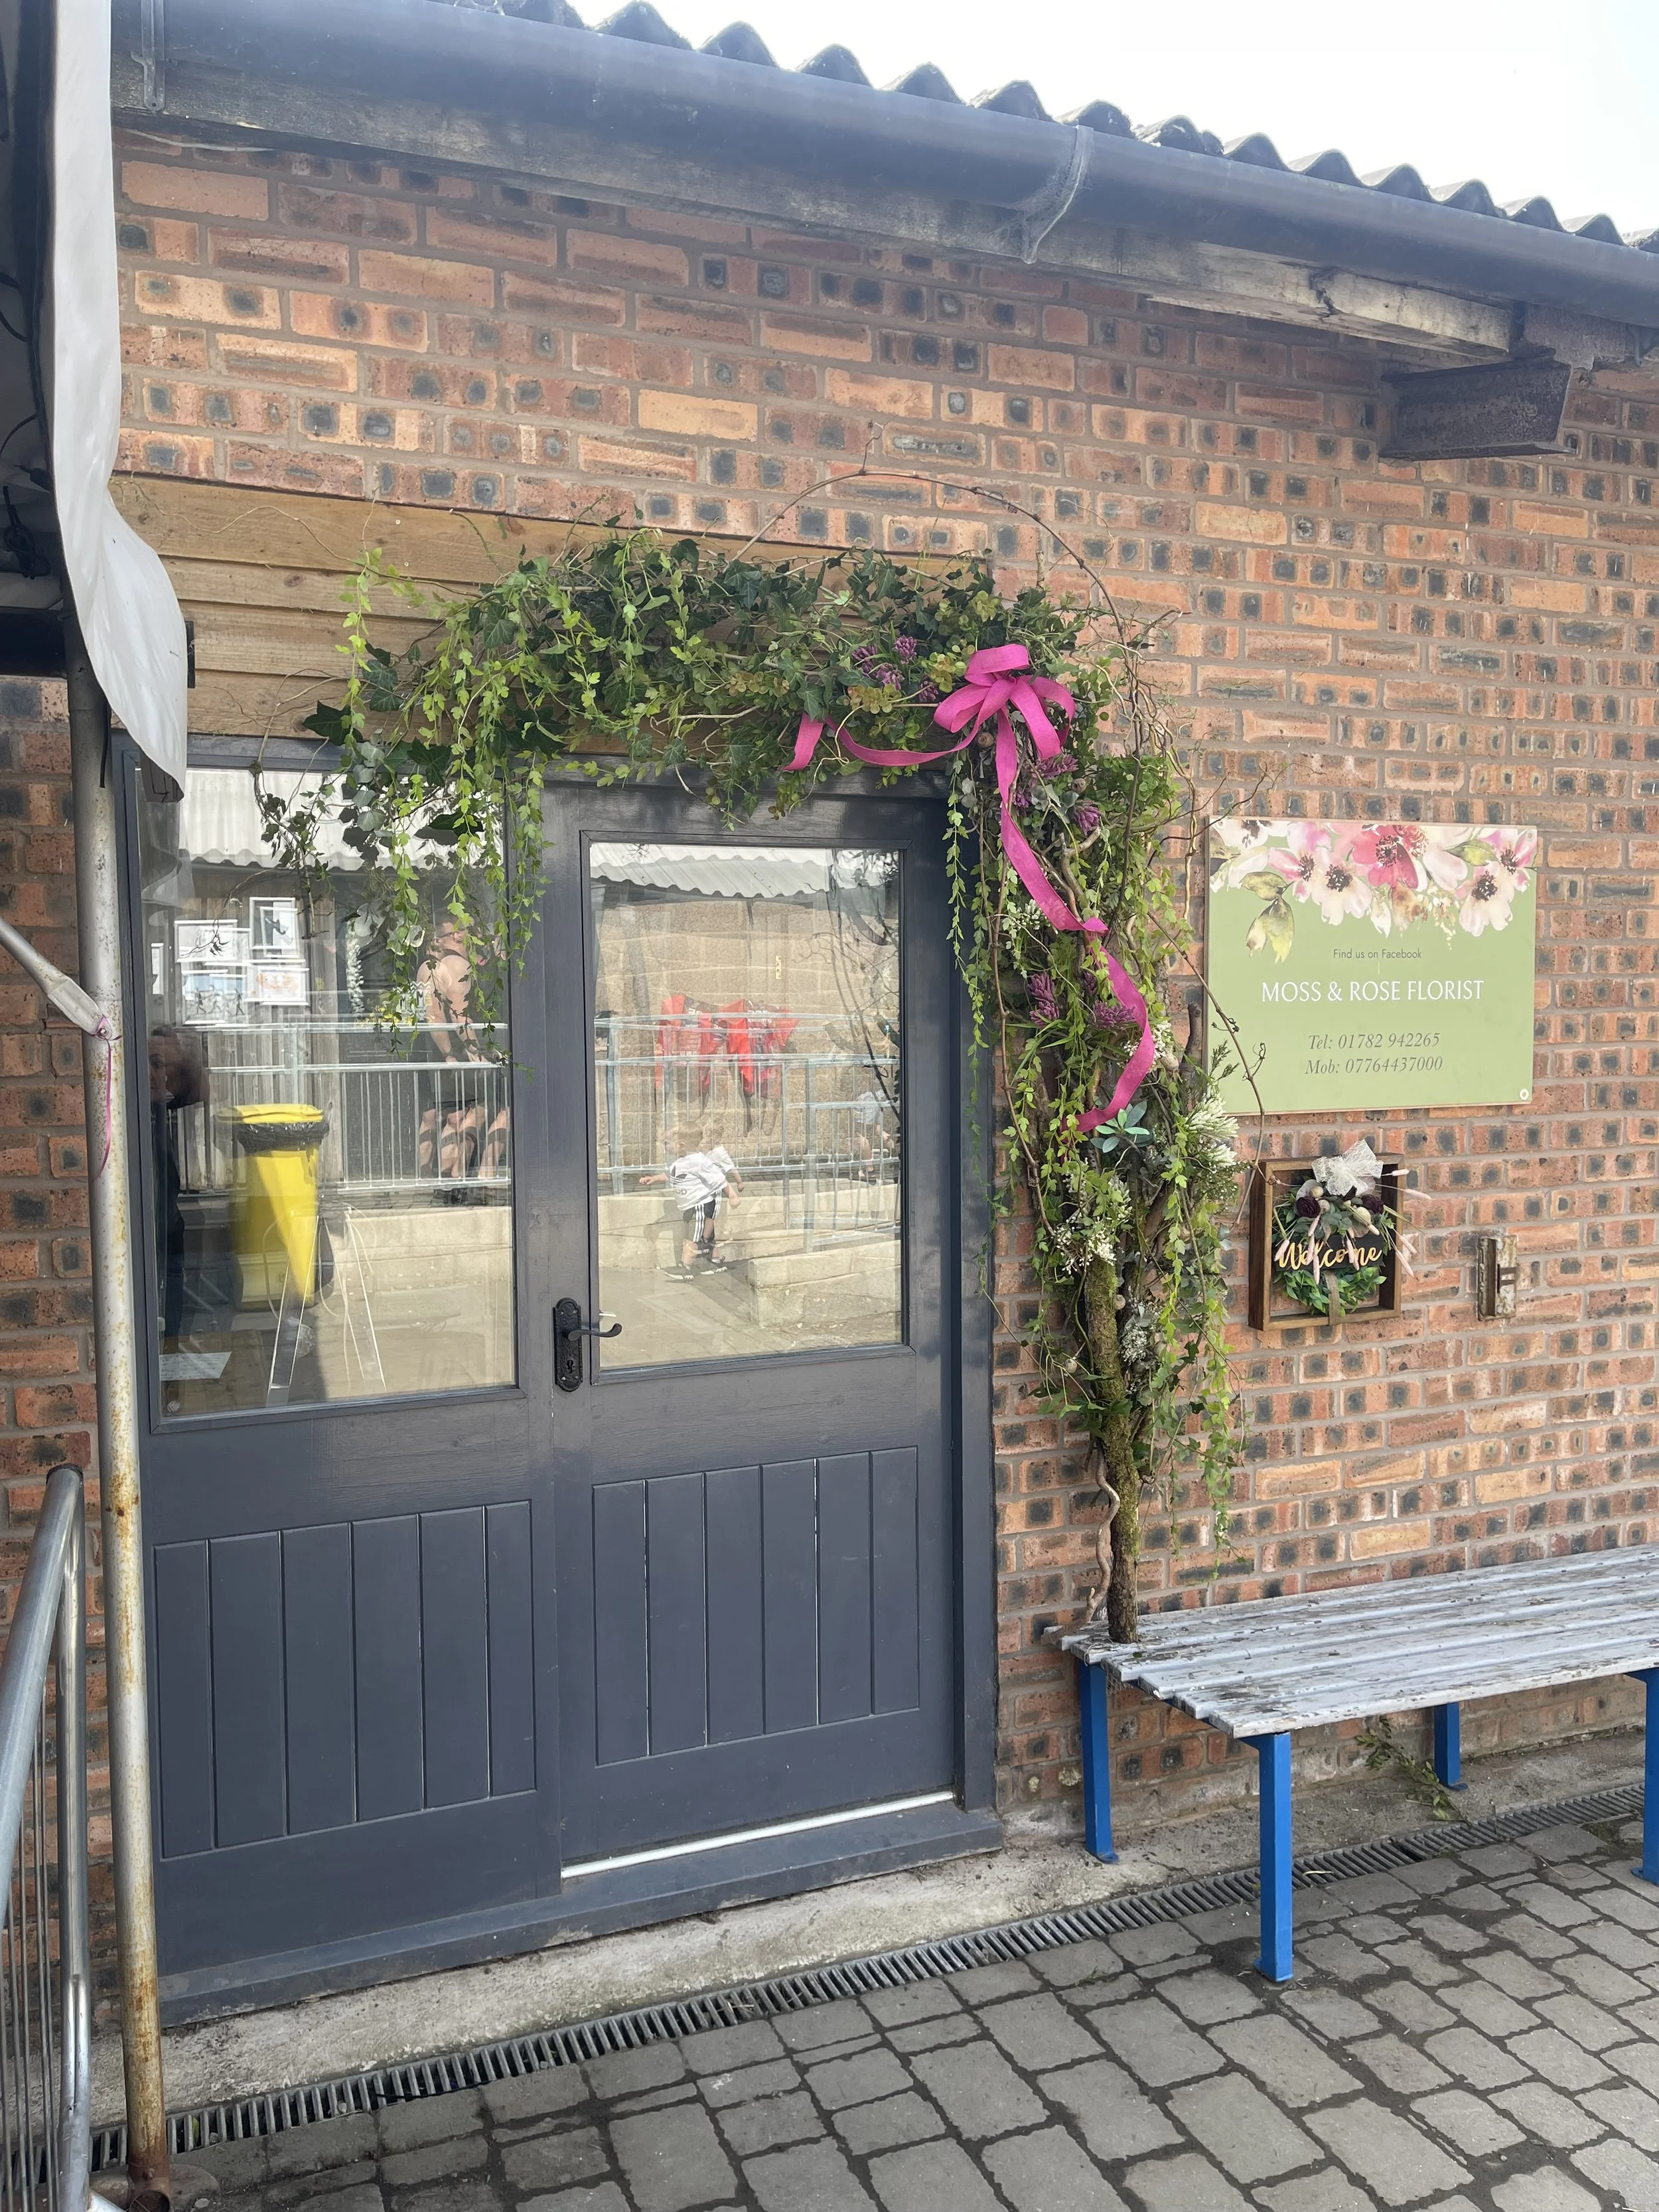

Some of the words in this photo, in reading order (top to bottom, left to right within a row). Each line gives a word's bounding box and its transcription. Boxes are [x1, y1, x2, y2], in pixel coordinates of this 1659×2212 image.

[1333, 948, 1352, 959] Find
[1382, 948, 1422, 959] Facebook
[1262, 981, 1321, 1002] MOSS
[1328, 981, 1342, 1001] &
[1350, 980, 1401, 1001] ROSE
[1407, 980, 1485, 1000] FLORIST
[1309, 1034, 1333, 1050] Tel:
[1338, 1033, 1383, 1049] 01782
[1388, 1033, 1440, 1048] 942265
[1305, 1059, 1340, 1074] Mob:
[1345, 1056, 1443, 1073] 07764437000
